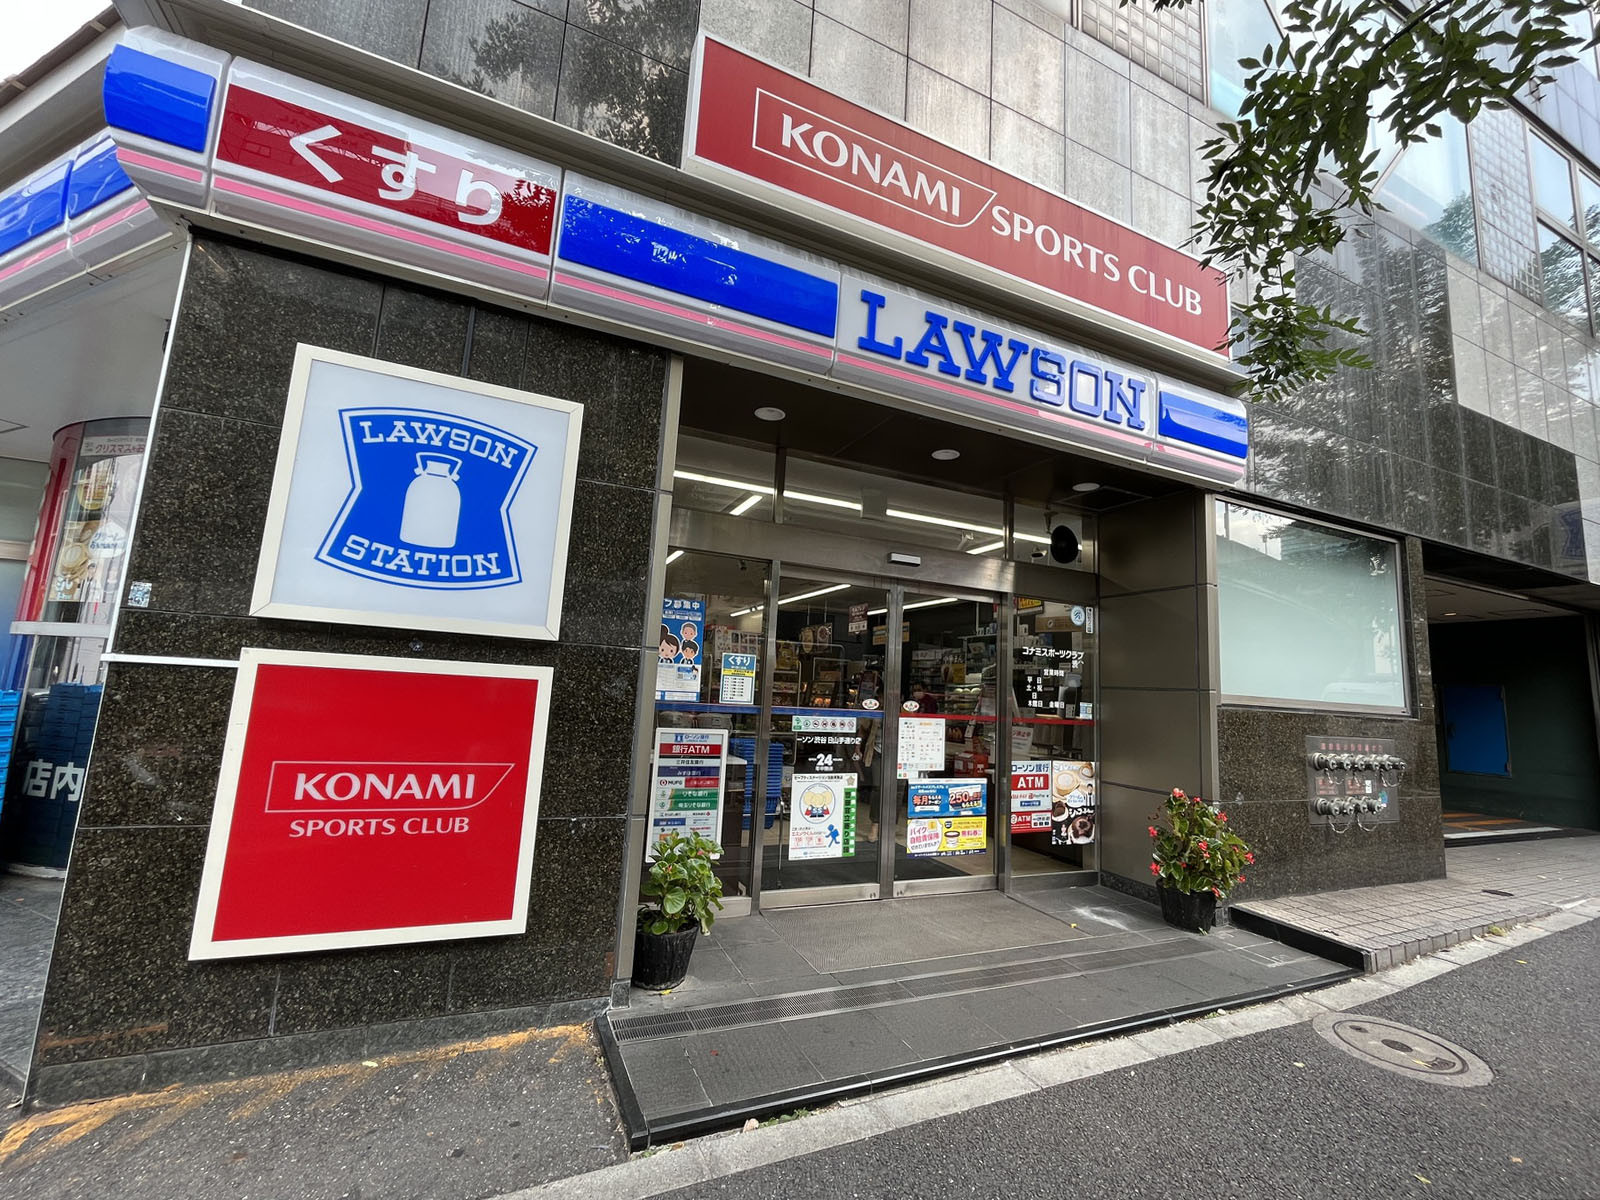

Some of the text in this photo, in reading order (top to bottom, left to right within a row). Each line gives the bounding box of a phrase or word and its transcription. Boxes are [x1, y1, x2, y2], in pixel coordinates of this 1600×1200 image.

[289, 124, 504, 226] くすり
[780, 113, 1202, 317] KONAMI SPORTS CLUB
[857, 289, 1147, 431] LAWSON
[359, 420, 519, 469] LAWSON
[341, 534, 502, 577] STATION
[728, 655, 751, 666] くすり
[672, 745, 710, 754] 銀行ATM
[816, 752, 833, 766] 24
[1012, 764, 1049, 773] ローソン銀行
[22, 758, 86, 802] 店内
[294, 772, 476, 801] KONAMI
[1017, 776, 1044, 788] ATM
[913, 795, 929, 805] 毎月
[950, 791, 969, 804] 250
[289, 816, 470, 838] SPORTS CLUB
[910, 826, 927, 836] バイク
